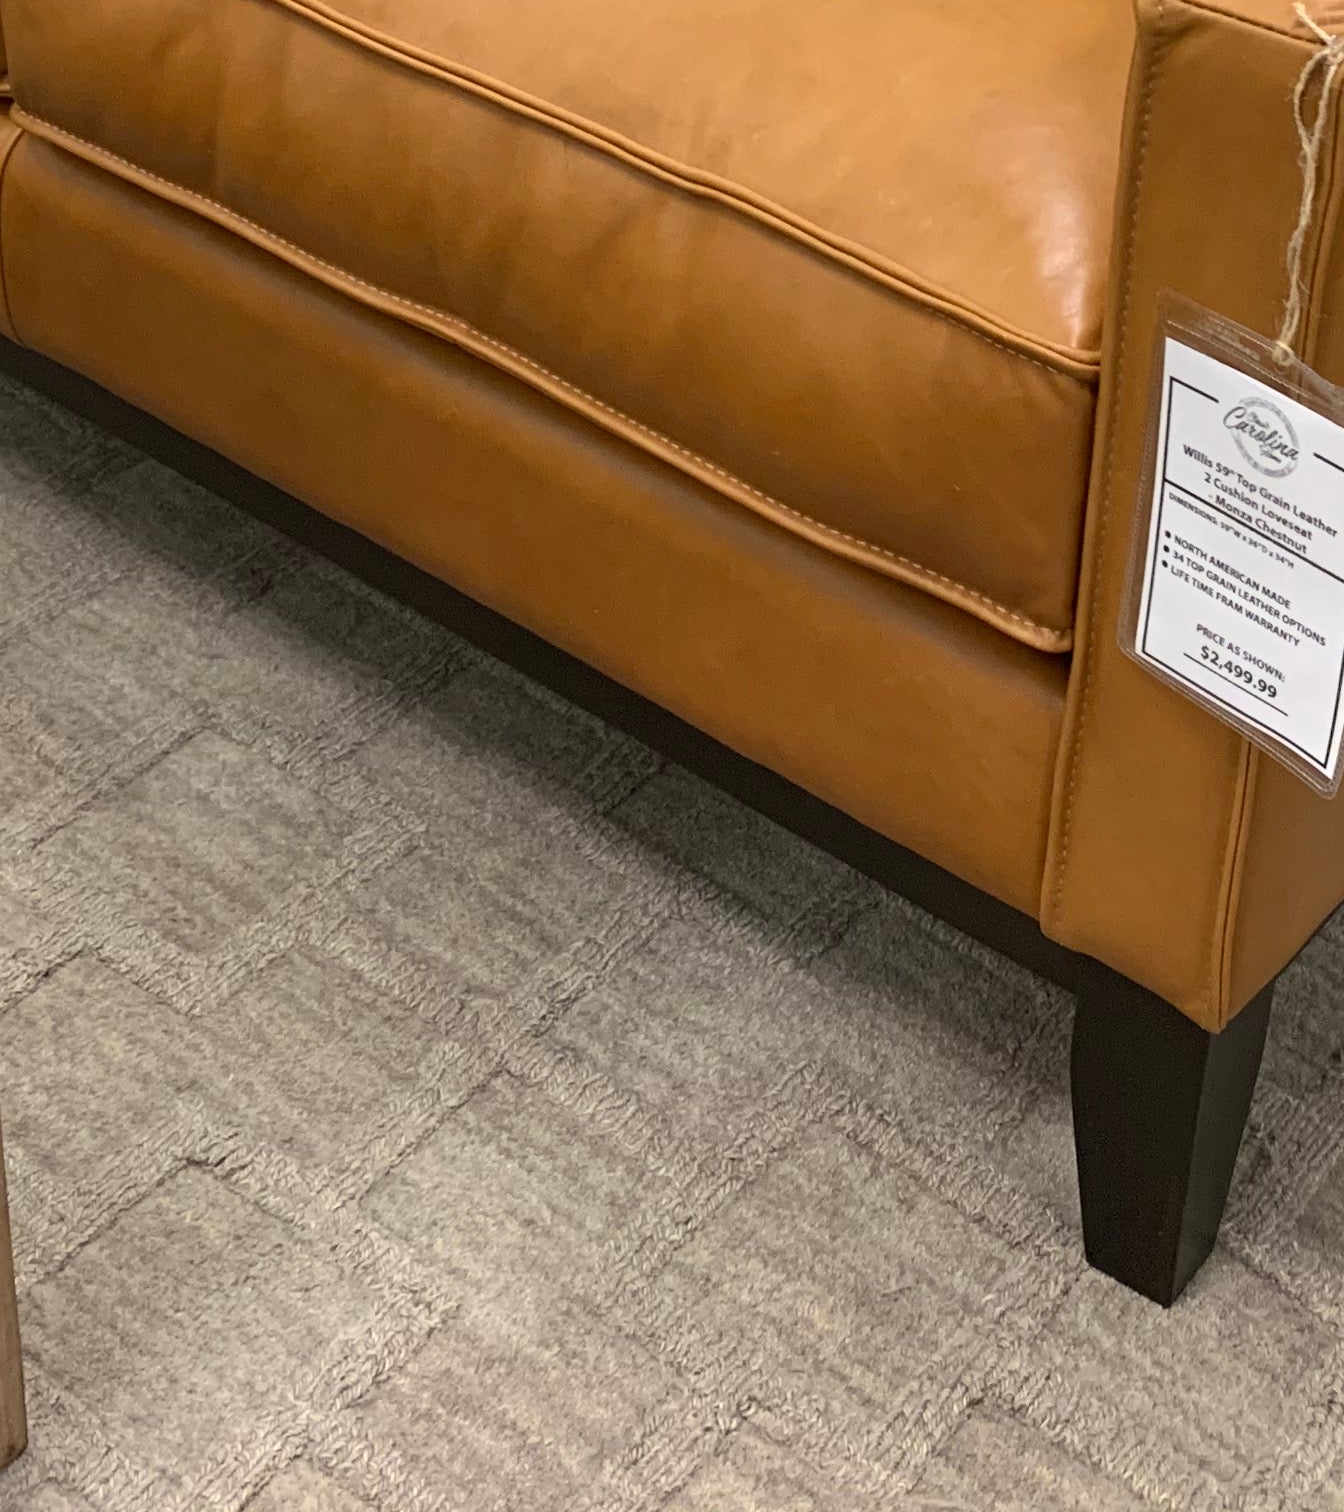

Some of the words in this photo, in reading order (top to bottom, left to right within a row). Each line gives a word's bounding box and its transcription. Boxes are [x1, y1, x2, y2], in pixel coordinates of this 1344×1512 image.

[1223, 406, 1299, 461] Carolina
[1183, 444, 1213, 468] Willis
[1237, 473, 1256, 492] Top
[1259, 488, 1290, 511] Grain
[1293, 505, 1338, 537] Leather
[1204, 472, 1211, 484] 2
[1214, 478, 1258, 510] Cushion
[1262, 504, 1312, 541] Loveseat
[1216, 495, 1252, 523] Monza
[1255, 518, 1307, 554] Chestnut
[1171, 565, 1190, 583] LIFE
[1192, 577, 1214, 598] TIME
[1216, 592, 1243, 614] FRAM
[1245, 608, 1300, 646] WARRANTY
[1175, 535, 1207, 561] NORTH
[1209, 556, 1259, 591] AMERICAN
[1262, 586, 1291, 609] MADE
[1186, 557, 1205, 573] TOP
[1206, 570, 1236, 593] GRAIN
[1238, 588, 1280, 619] LEATHER
[1282, 614, 1326, 646] OPTIONS
[1196, 623, 1226, 646] PRICE
[1227, 642, 1240, 656] AS
[1243, 650, 1286, 683] SHOWN:
[1200, 645, 1278, 698] $2,499.99
